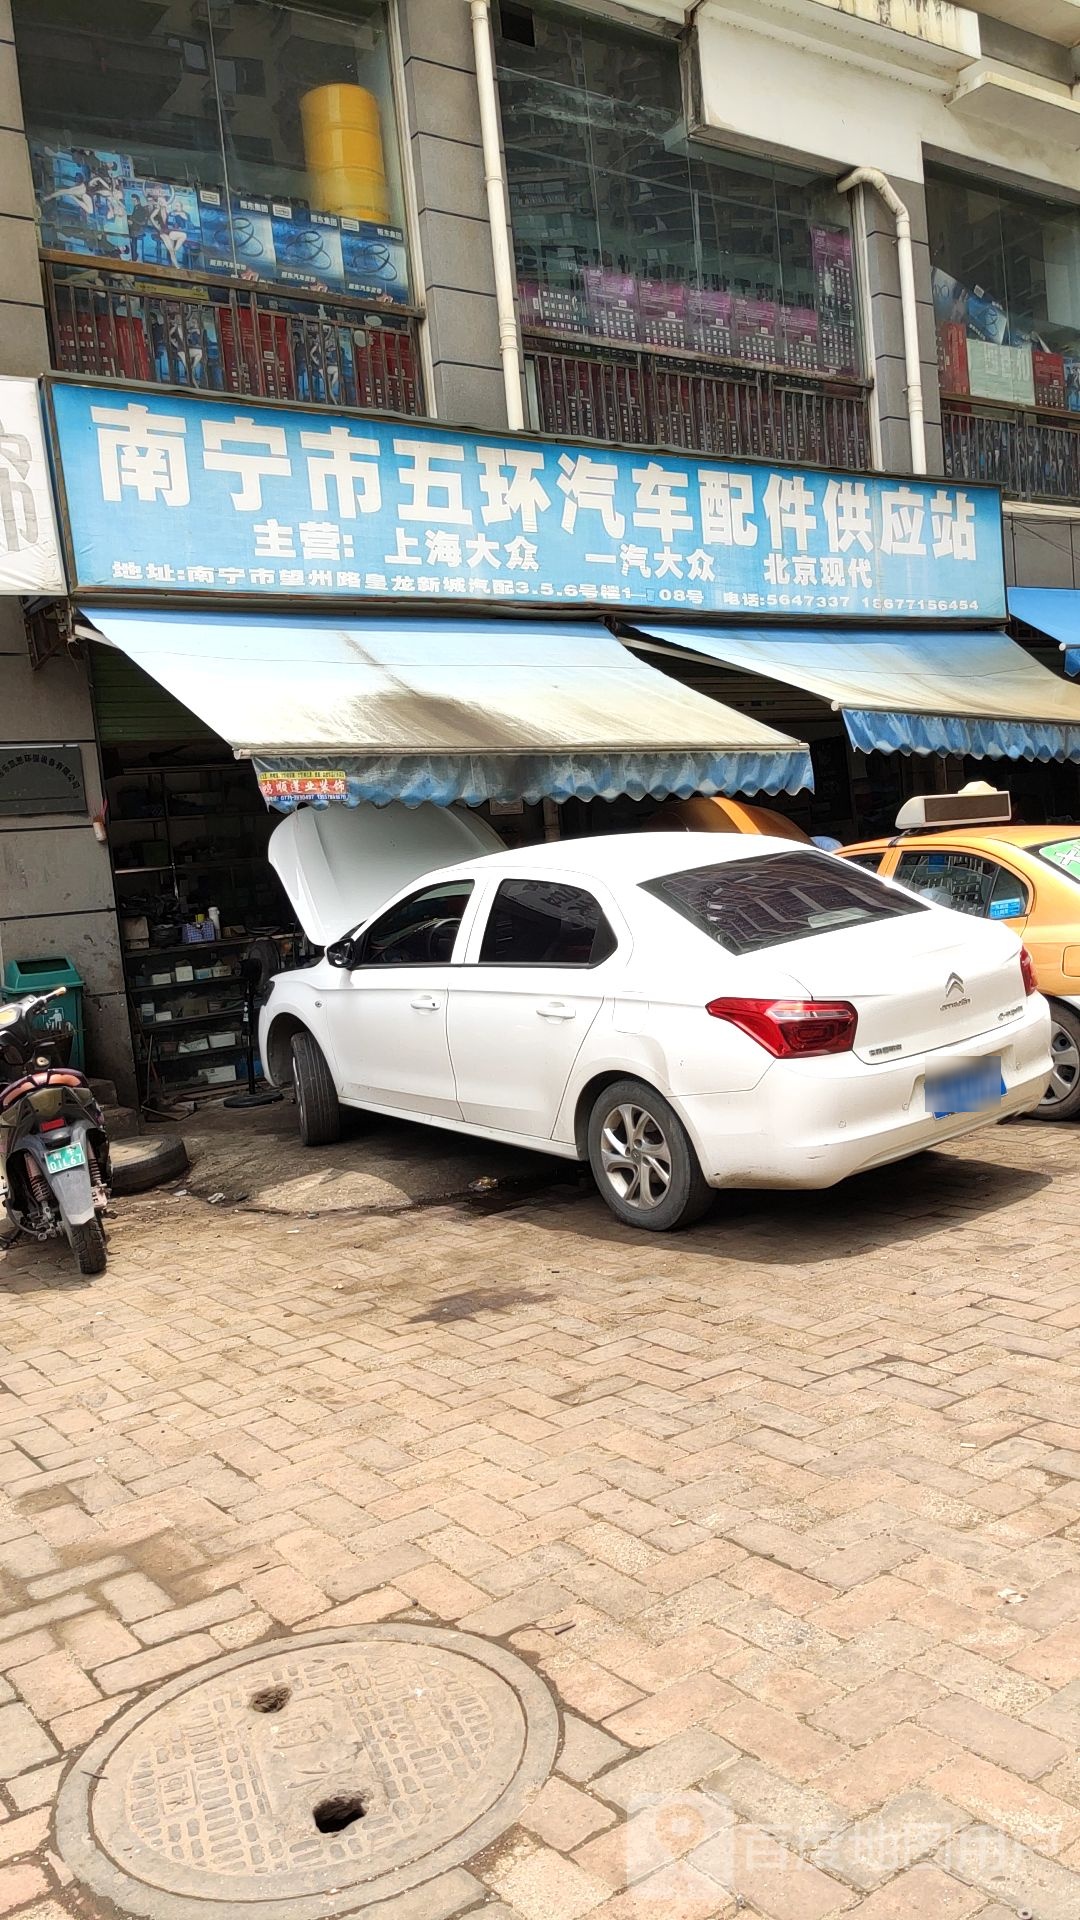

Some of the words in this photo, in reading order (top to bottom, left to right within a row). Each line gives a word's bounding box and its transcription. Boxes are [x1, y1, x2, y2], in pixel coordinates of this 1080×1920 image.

[90, 403, 977, 561] 南宁市五环汽车配件供应站
[253, 518, 355, 561] 主营:
[385, 528, 539, 573] 上海大众
[585, 543, 716, 583] 一汽大众
[764, 553, 873, 588] 北京现代
